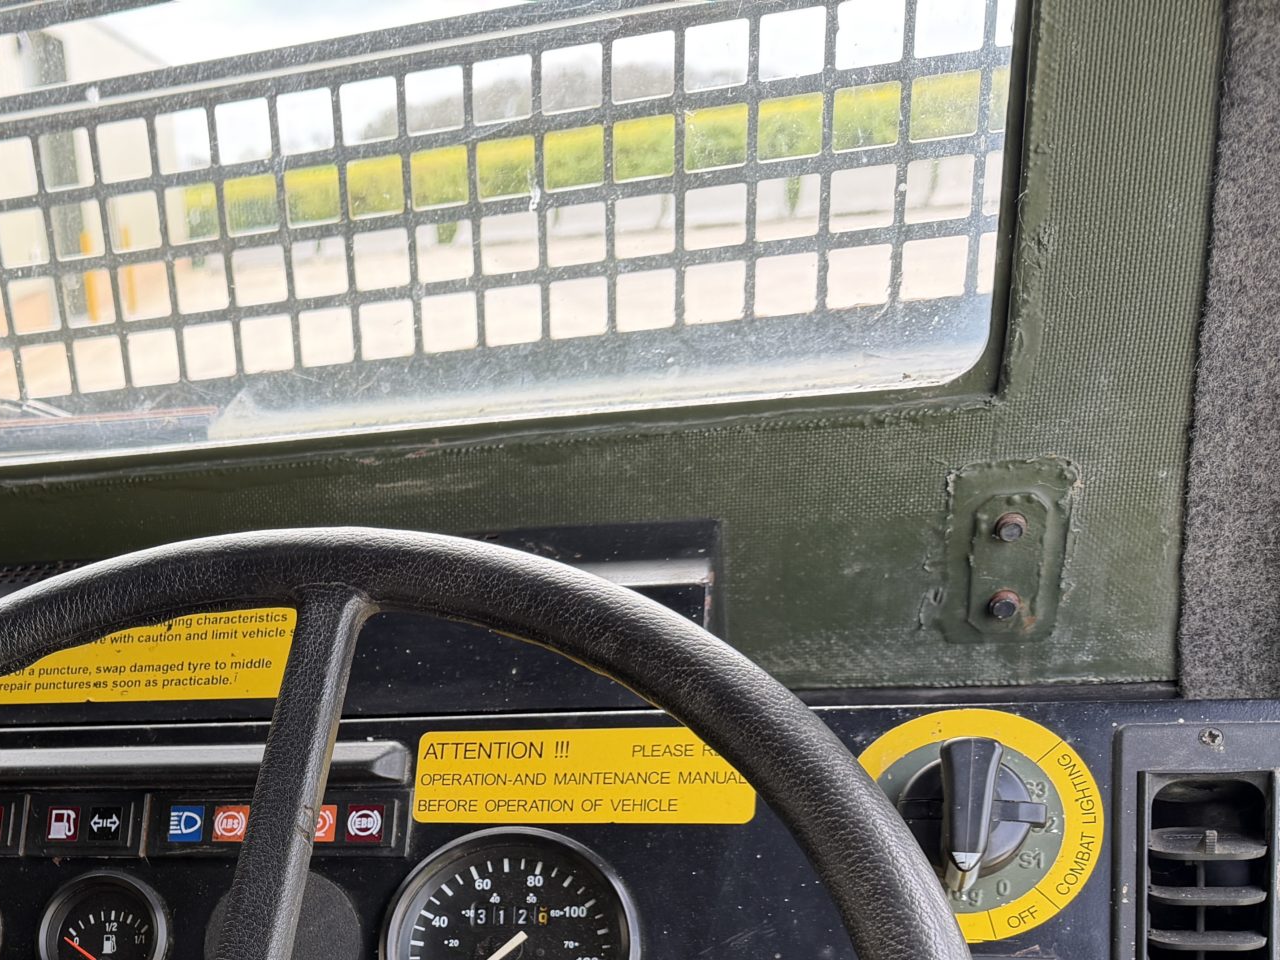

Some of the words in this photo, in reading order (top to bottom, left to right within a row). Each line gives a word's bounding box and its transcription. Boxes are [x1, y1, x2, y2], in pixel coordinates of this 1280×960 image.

[196, 612, 288, 625] characteristics
[111, 634, 133, 644] with
[138, 631, 182, 643] caution
[185, 630, 207, 641] and
[212, 629, 238, 640] limit
[242, 627, 286, 638] vehicle
[28, 668, 35, 676] a
[38, 666, 92, 678] puncture,
[96, 664, 126, 676] swap
[129, 661, 184, 674] damaged
[188, 661, 210, 674] tyre
[214, 660, 227, 670] to
[230, 658, 272, 670] middle
[0, 681, 32, 692] repair
[34, 679, 92, 692] punctures
[95, 681, 108, 689] as
[112, 679, 140, 689] soon
[144, 678, 158, 687] as
[162, 675, 233, 689] practicable.
[423, 741, 544, 760] ATTENTION
[554, 740, 570, 759] !!!
[631, 743, 694, 758] PLEASE
[553, 771, 670, 785] MAINTENANCE
[1056, 752, 1097, 825] LIGHTING
[418, 799, 478, 813] BEFORE
[485, 799, 574, 813] OPERATION
[580, 799, 603, 812] OF
[610, 799, 678, 812] VEHICLE
[221, 818, 239, 829] ABS
[1055, 832, 1096, 896] COMBAT
[474, 878, 491, 890] 60
[527, 875, 543, 887] 80
[489, 896, 500, 904] 40
[526, 895, 537, 903] 50
[563, 906, 587, 918] 100
[1006, 905, 1039, 929] OFF
[105, 922, 118, 932] 1/2
[432, 916, 449, 928] 40
[134, 935, 146, 945] 1/1
[448, 939, 459, 947] 20
[564, 941, 575, 949] 70
